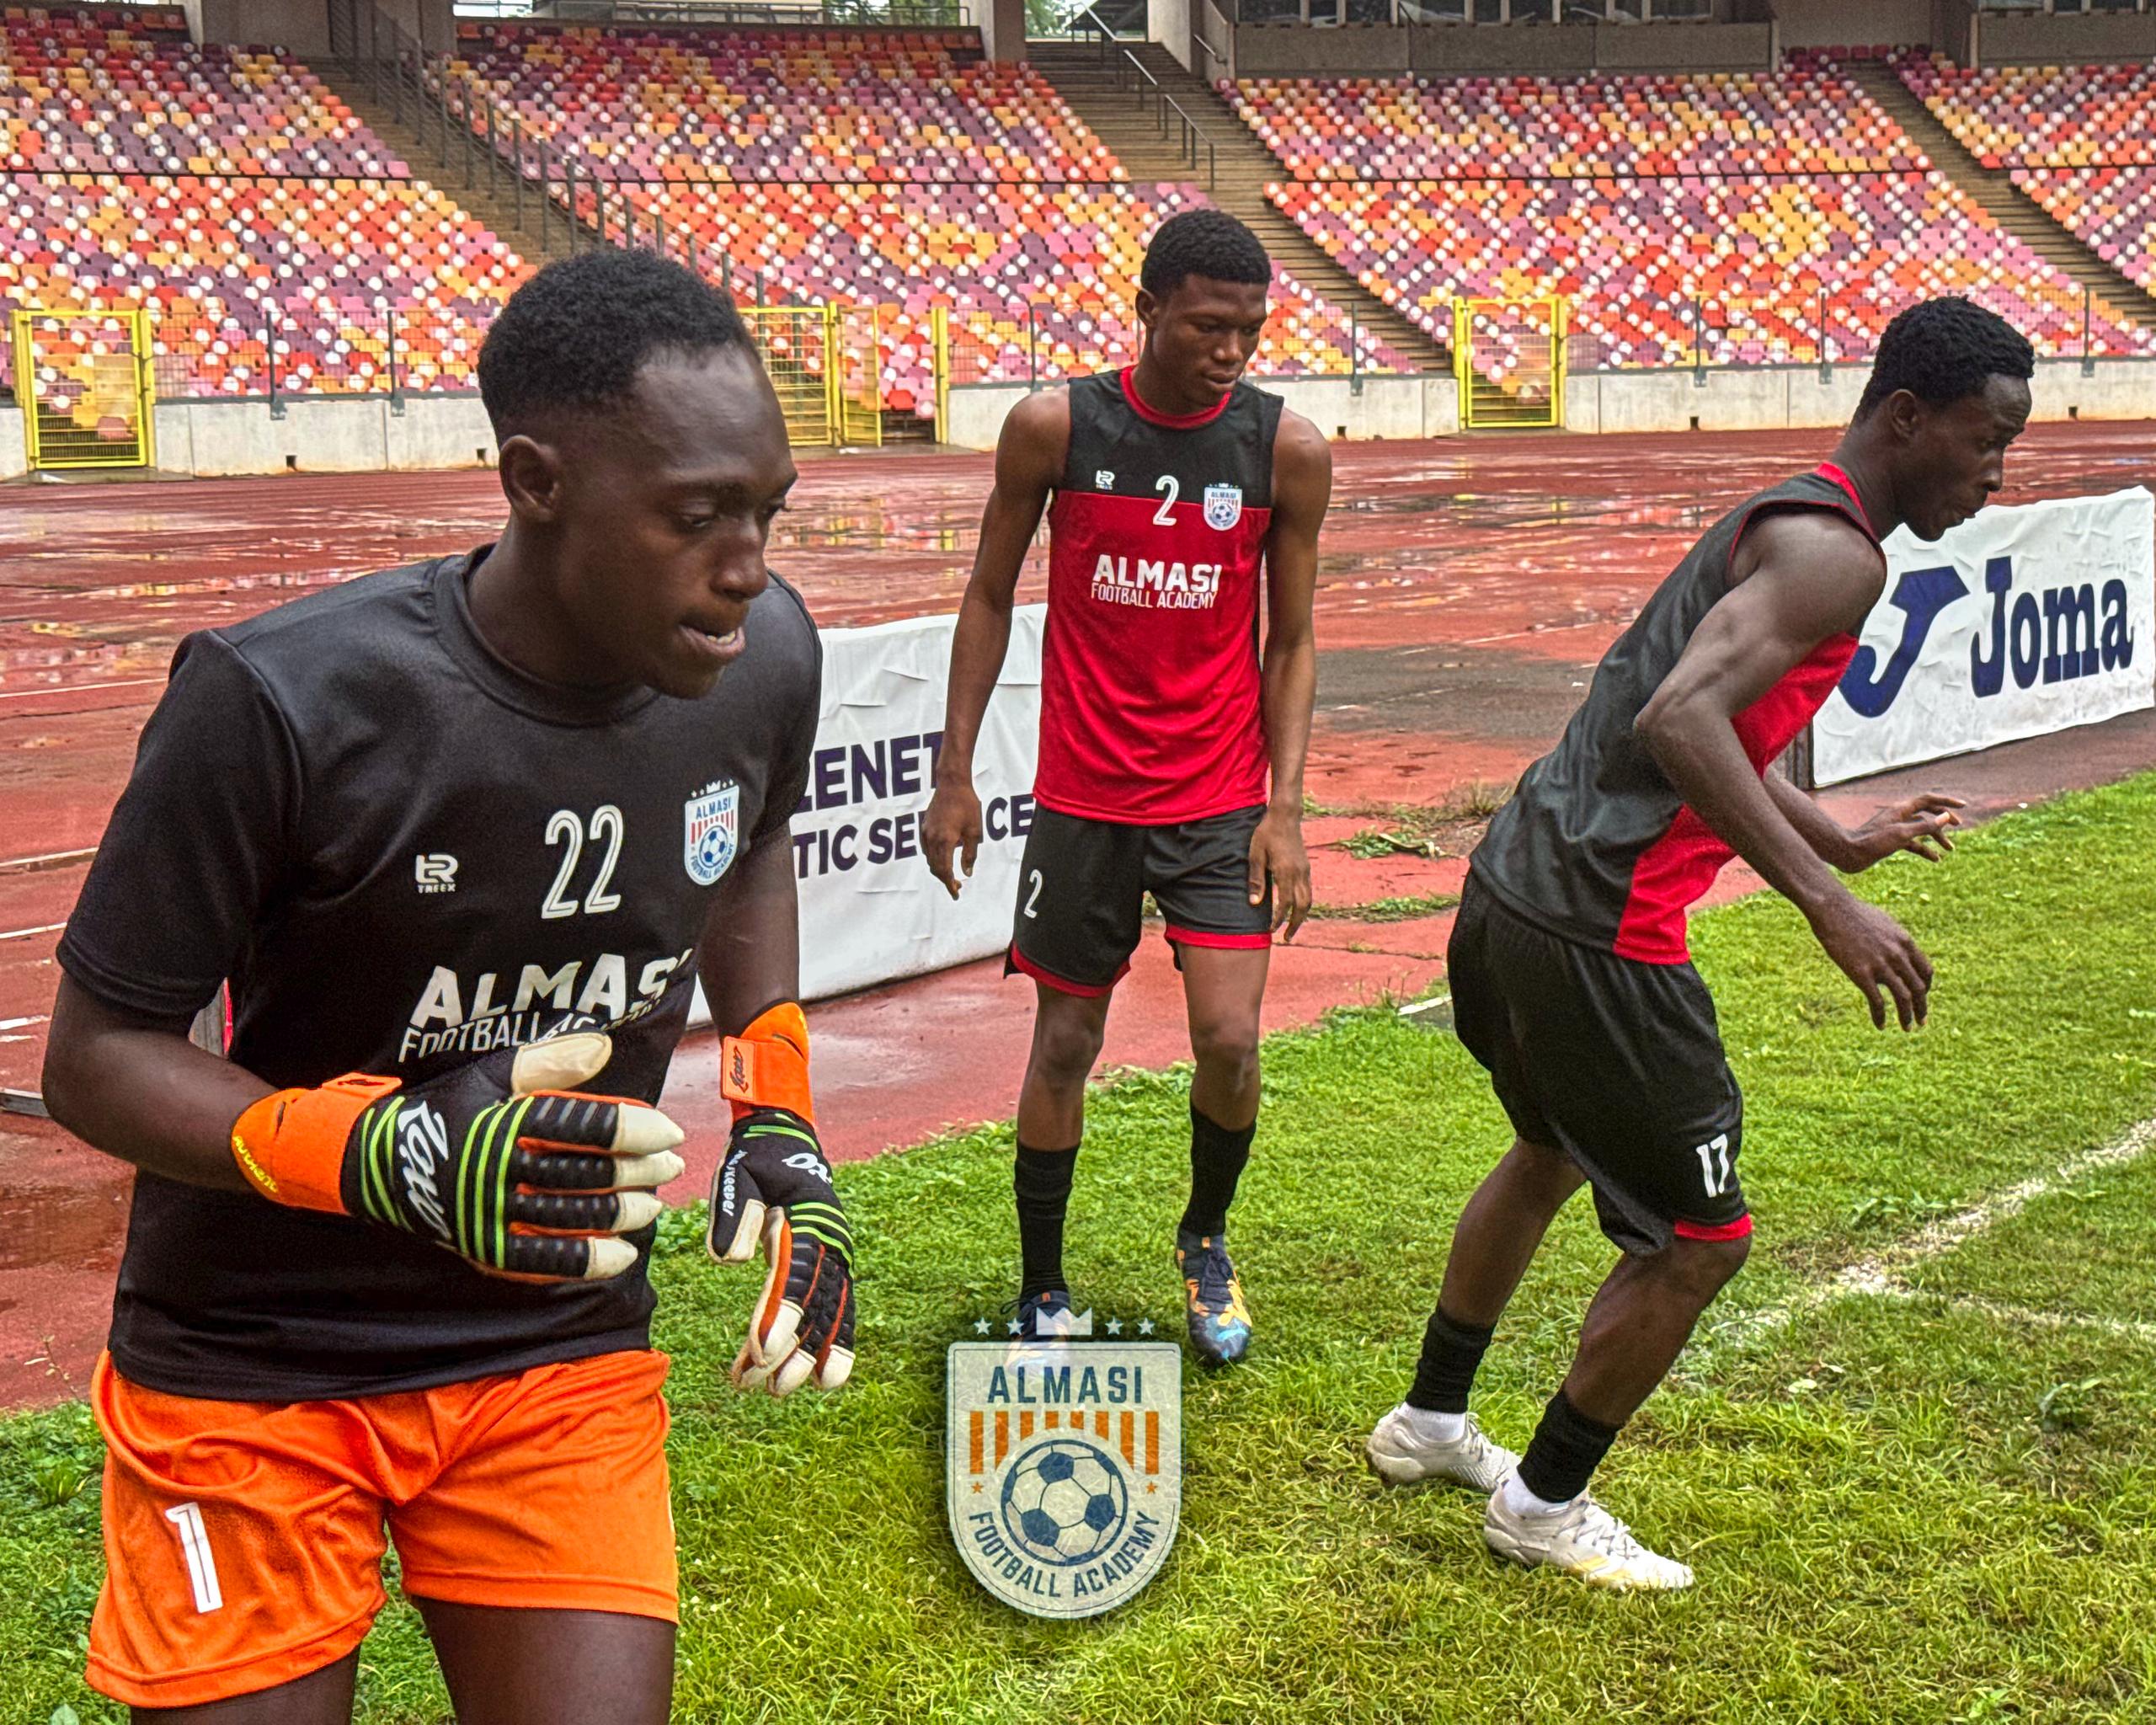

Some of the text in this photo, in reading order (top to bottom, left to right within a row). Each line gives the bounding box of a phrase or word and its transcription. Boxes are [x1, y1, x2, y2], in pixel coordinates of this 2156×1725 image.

[1153, 475, 1179, 526] 2
[1091, 581, 1218, 610] FOOTBALL ACADEMY
[1092, 553, 1223, 593] ALMASI
[1971, 555, 2135, 698] Joma
[792, 730, 946, 814] ENET
[696, 796, 732, 820] ALMASI
[542, 804, 623, 919] 22
[417, 883, 456, 894] TREEX
[1023, 868, 1043, 919] 2
[1695, 1133, 1730, 1198] 17
[165, 1501, 223, 1613] 1
